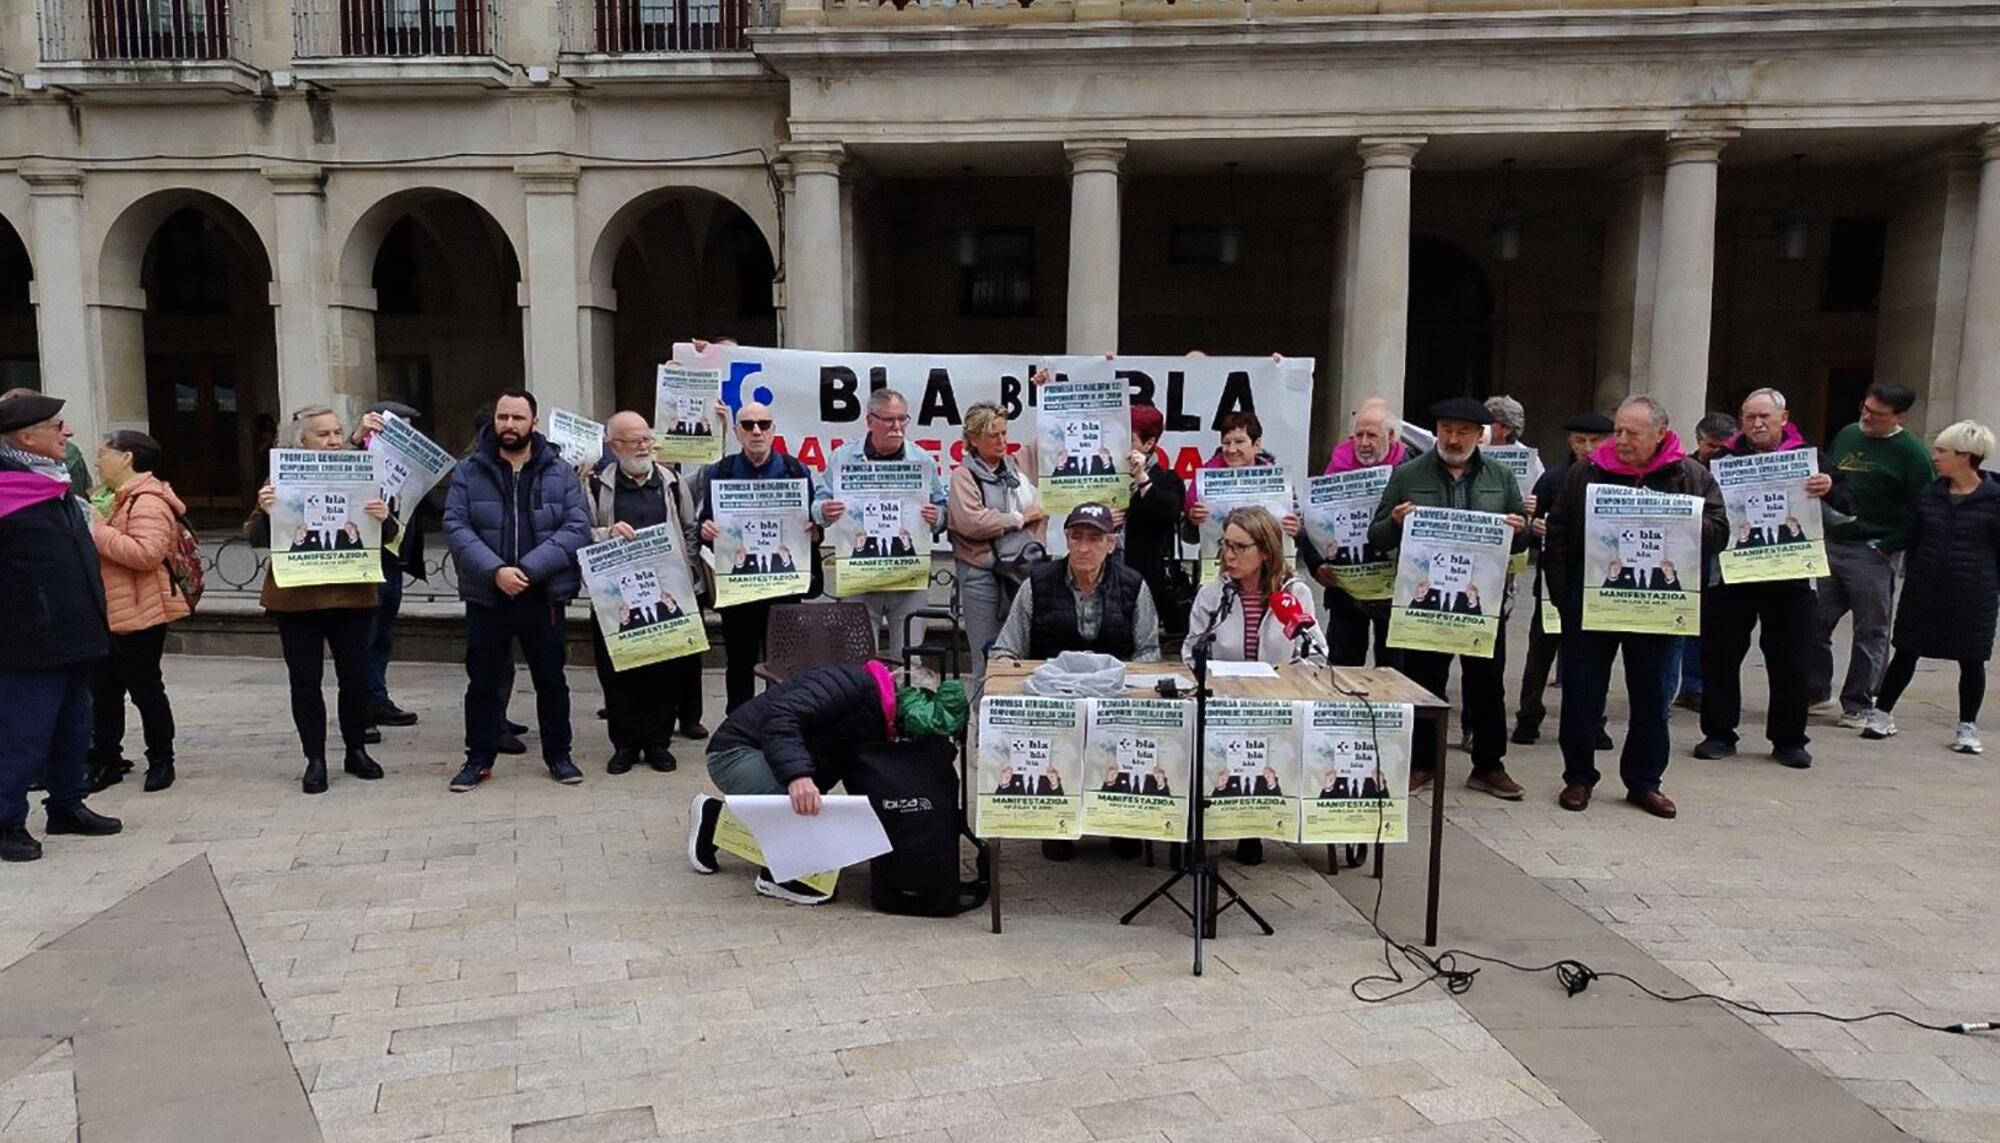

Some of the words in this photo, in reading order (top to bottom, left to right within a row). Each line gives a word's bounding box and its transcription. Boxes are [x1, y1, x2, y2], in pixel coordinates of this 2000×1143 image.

[325, 495, 346, 504] bla
[1764, 494, 1784, 502] bla
[326, 505, 344, 513] bla
[880, 503, 899, 512] bla
[760, 521, 778, 529] bla
[1640, 530, 1662, 539] bla
[1641, 542, 1659, 550] bla
[1734, 544, 1812, 557] MANIFESTAZIOA
[288, 552, 369, 561] MANIFESTAZIOA
[1450, 555, 1470, 565] bla
[849, 559, 920, 567] MANIFESTAZIOA
[634, 571, 654, 581] bla
[729, 574, 799, 582] MANIFESTAZIOA
[1599, 591, 1686, 600] MANIFESTAZIOA
[1405, 610, 1486, 625] MANIFESTAZIOA
[618, 619, 690, 640] MANIFESTAZIOA
[1029, 741, 1048, 749] bla
[1135, 740, 1155, 748] bla
[1246, 740, 1264, 749] bla
[1354, 742, 1375, 750] bla
[993, 797, 1068, 805] MANIFESTAZIOA
[1098, 795, 1175, 806] MANIFESTAZIOA
